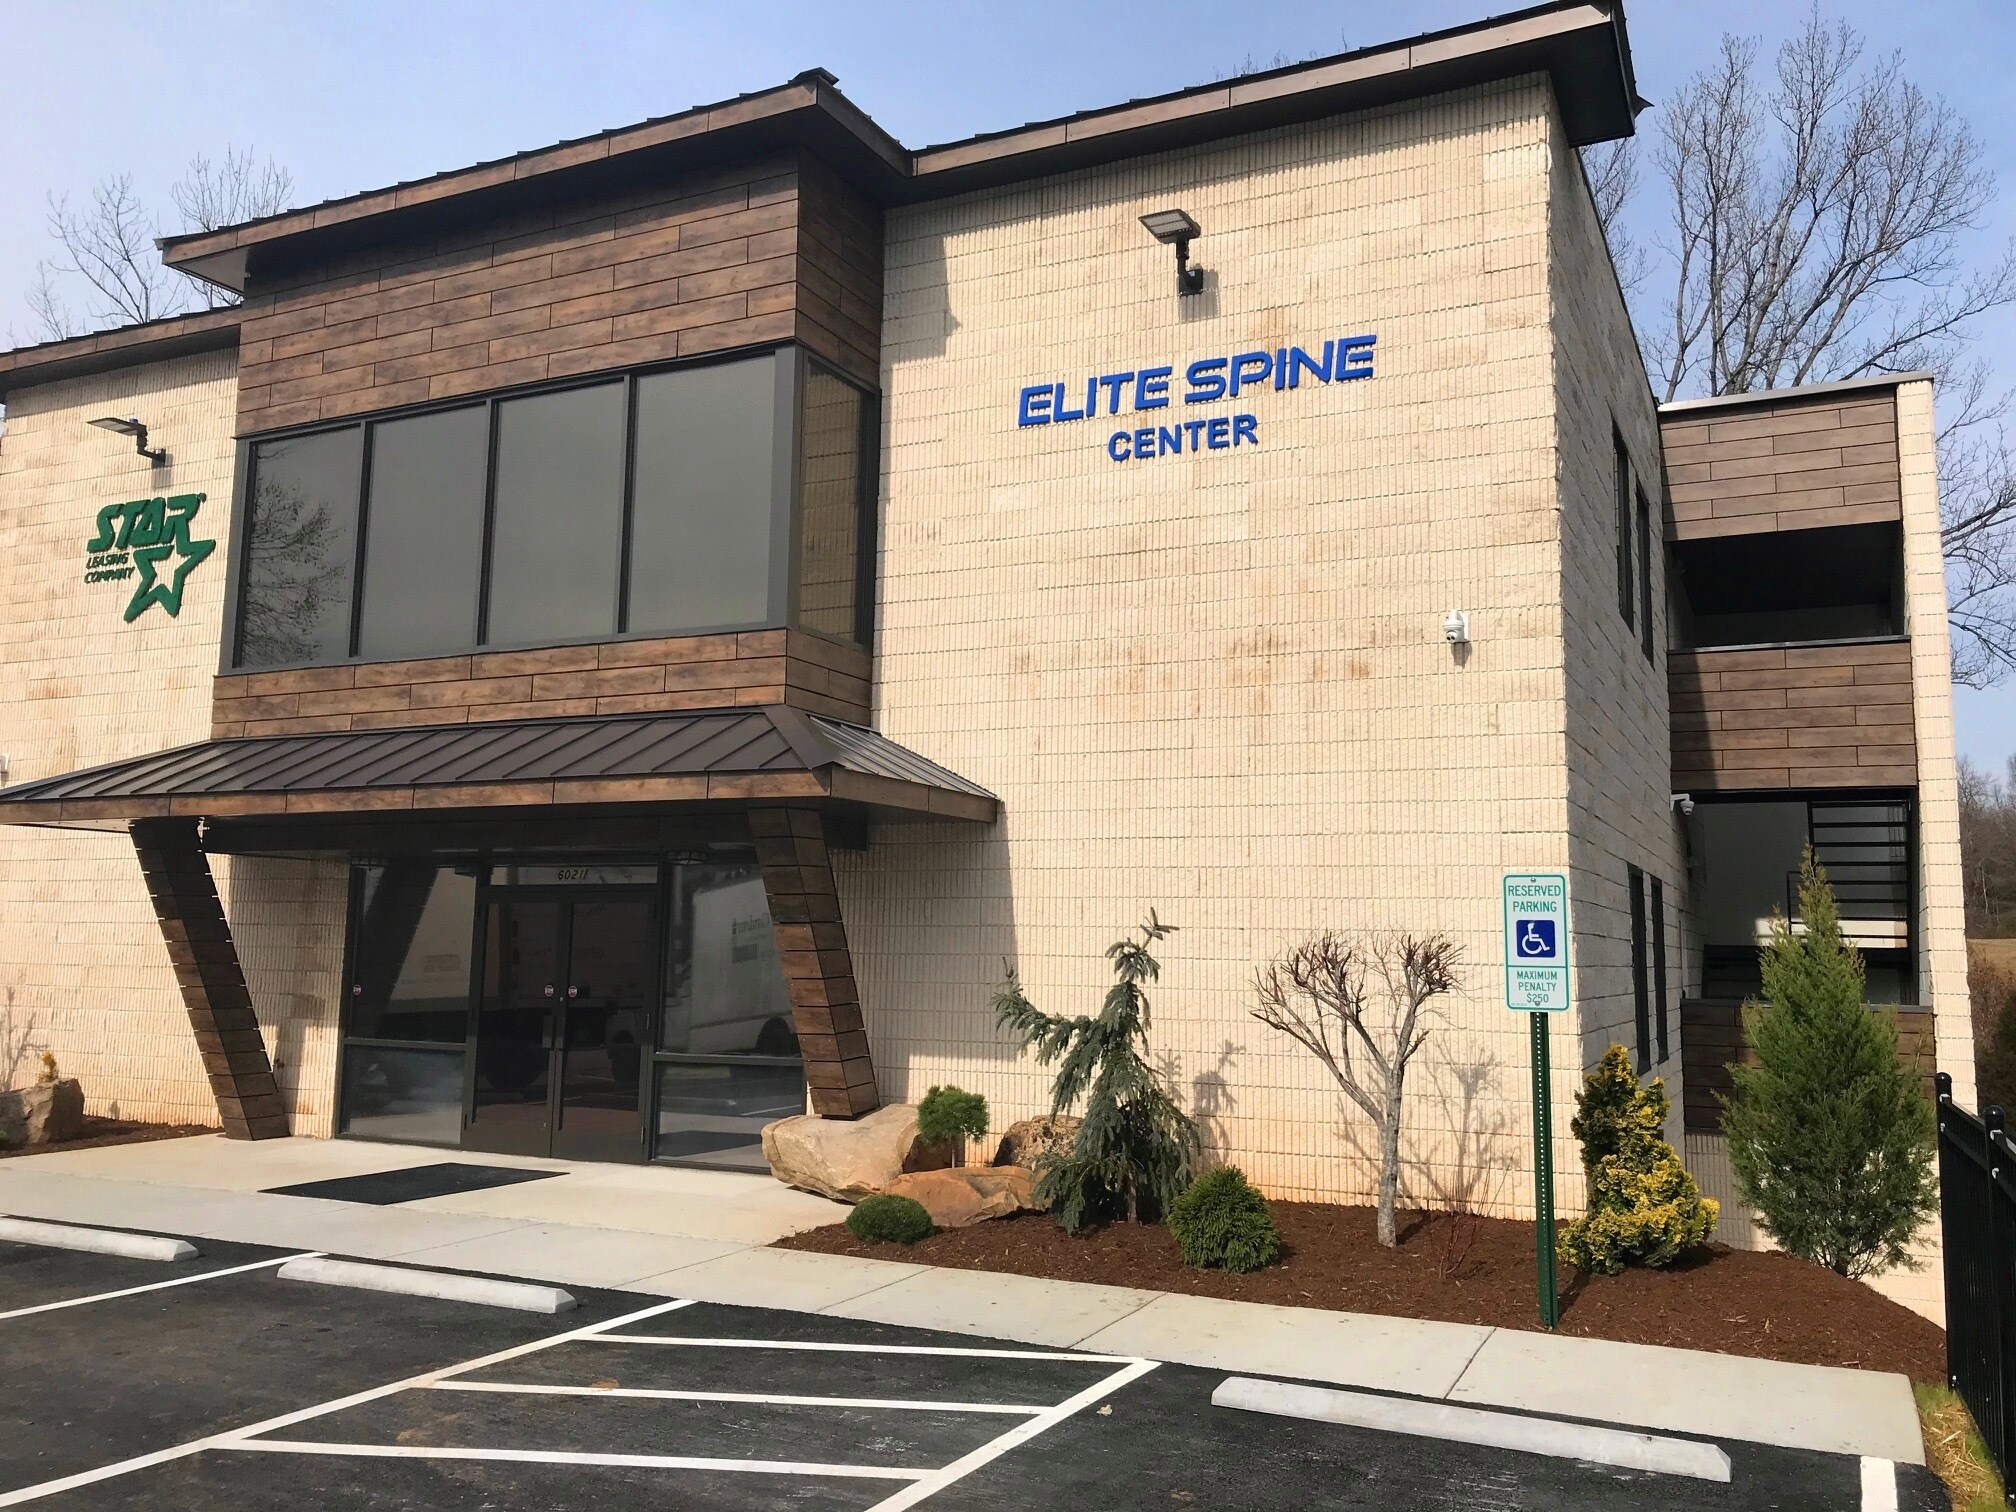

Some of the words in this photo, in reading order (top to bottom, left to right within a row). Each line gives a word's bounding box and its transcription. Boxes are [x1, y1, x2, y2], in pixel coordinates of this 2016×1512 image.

[1018, 366, 1173, 427] ELITE
[1184, 334, 1377, 405] SPINE
[1107, 413, 1259, 462] CENTER
[86, 493, 203, 553] STAR
[86, 552, 130, 570] LEASING
[84, 566, 135, 584] COMPANY
[1508, 885, 1561, 897] RESERVED
[1512, 901, 1557, 913] PARKING
[1516, 970, 1558, 980] MAXIMUM
[1518, 982, 1557, 992] PENALTY
[1526, 993, 1549, 1004] $250
